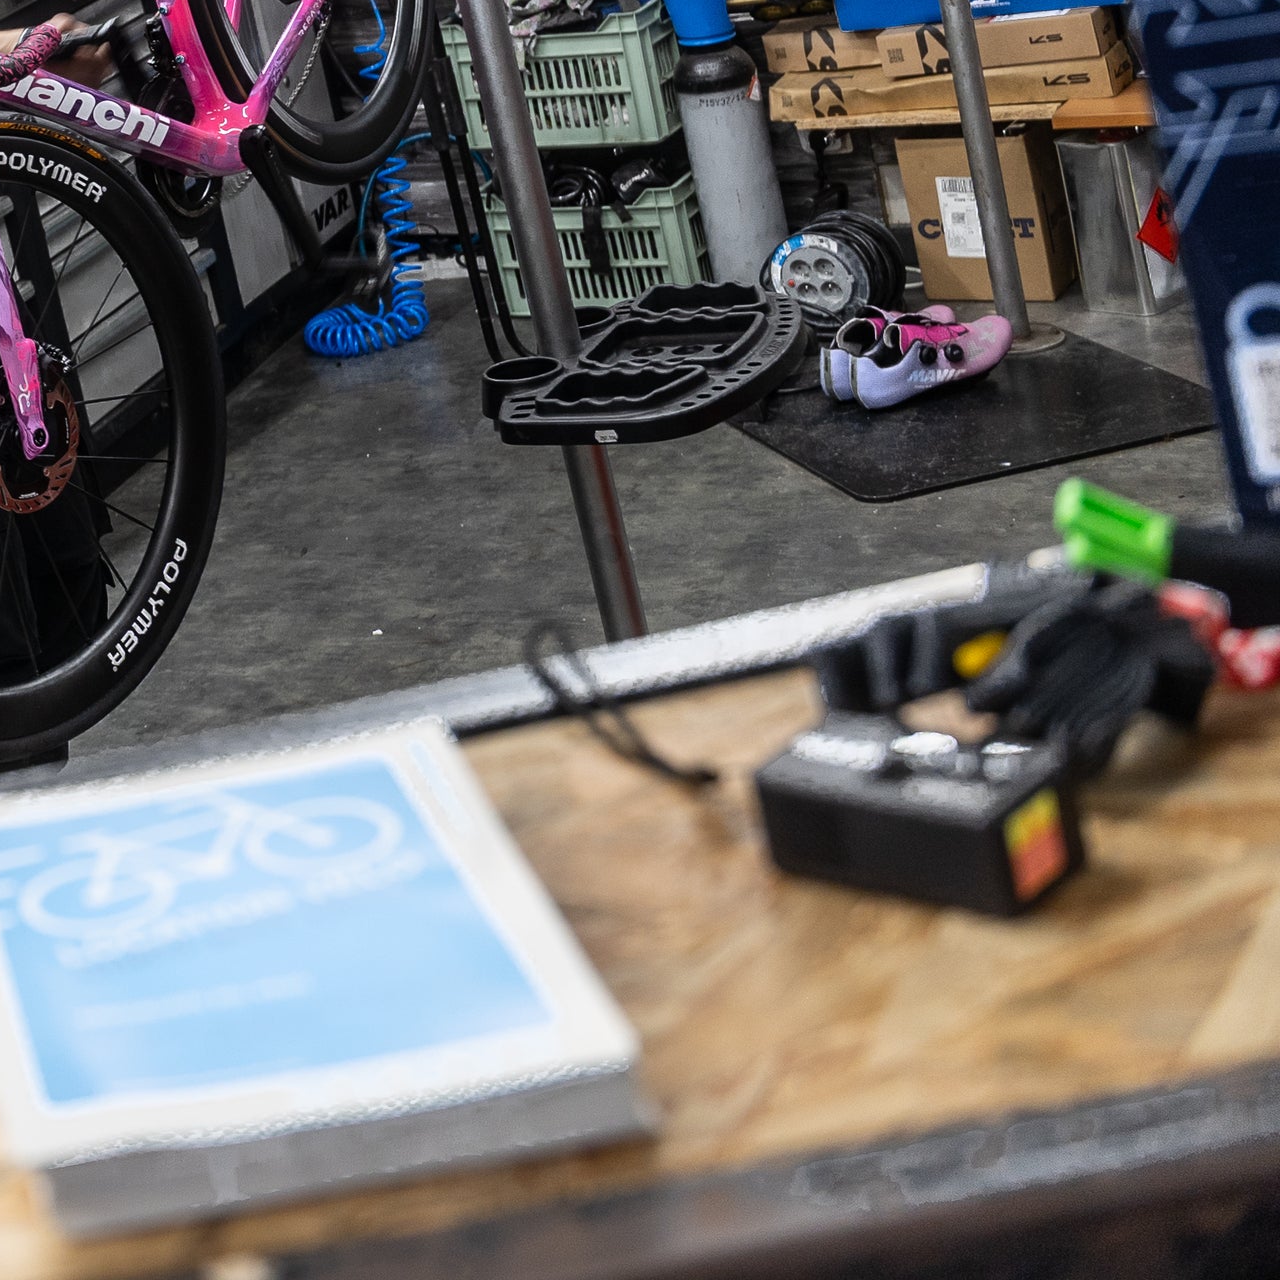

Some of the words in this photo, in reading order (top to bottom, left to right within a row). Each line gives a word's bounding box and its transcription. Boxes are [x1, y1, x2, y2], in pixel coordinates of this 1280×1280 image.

[1029, 33, 1064, 44] KS
[1042, 73, 1092, 87] KS
[312, 188, 351, 232] VAR
[907, 369, 965, 383] MAVIC
[107, 537, 188, 672] POLYMER
